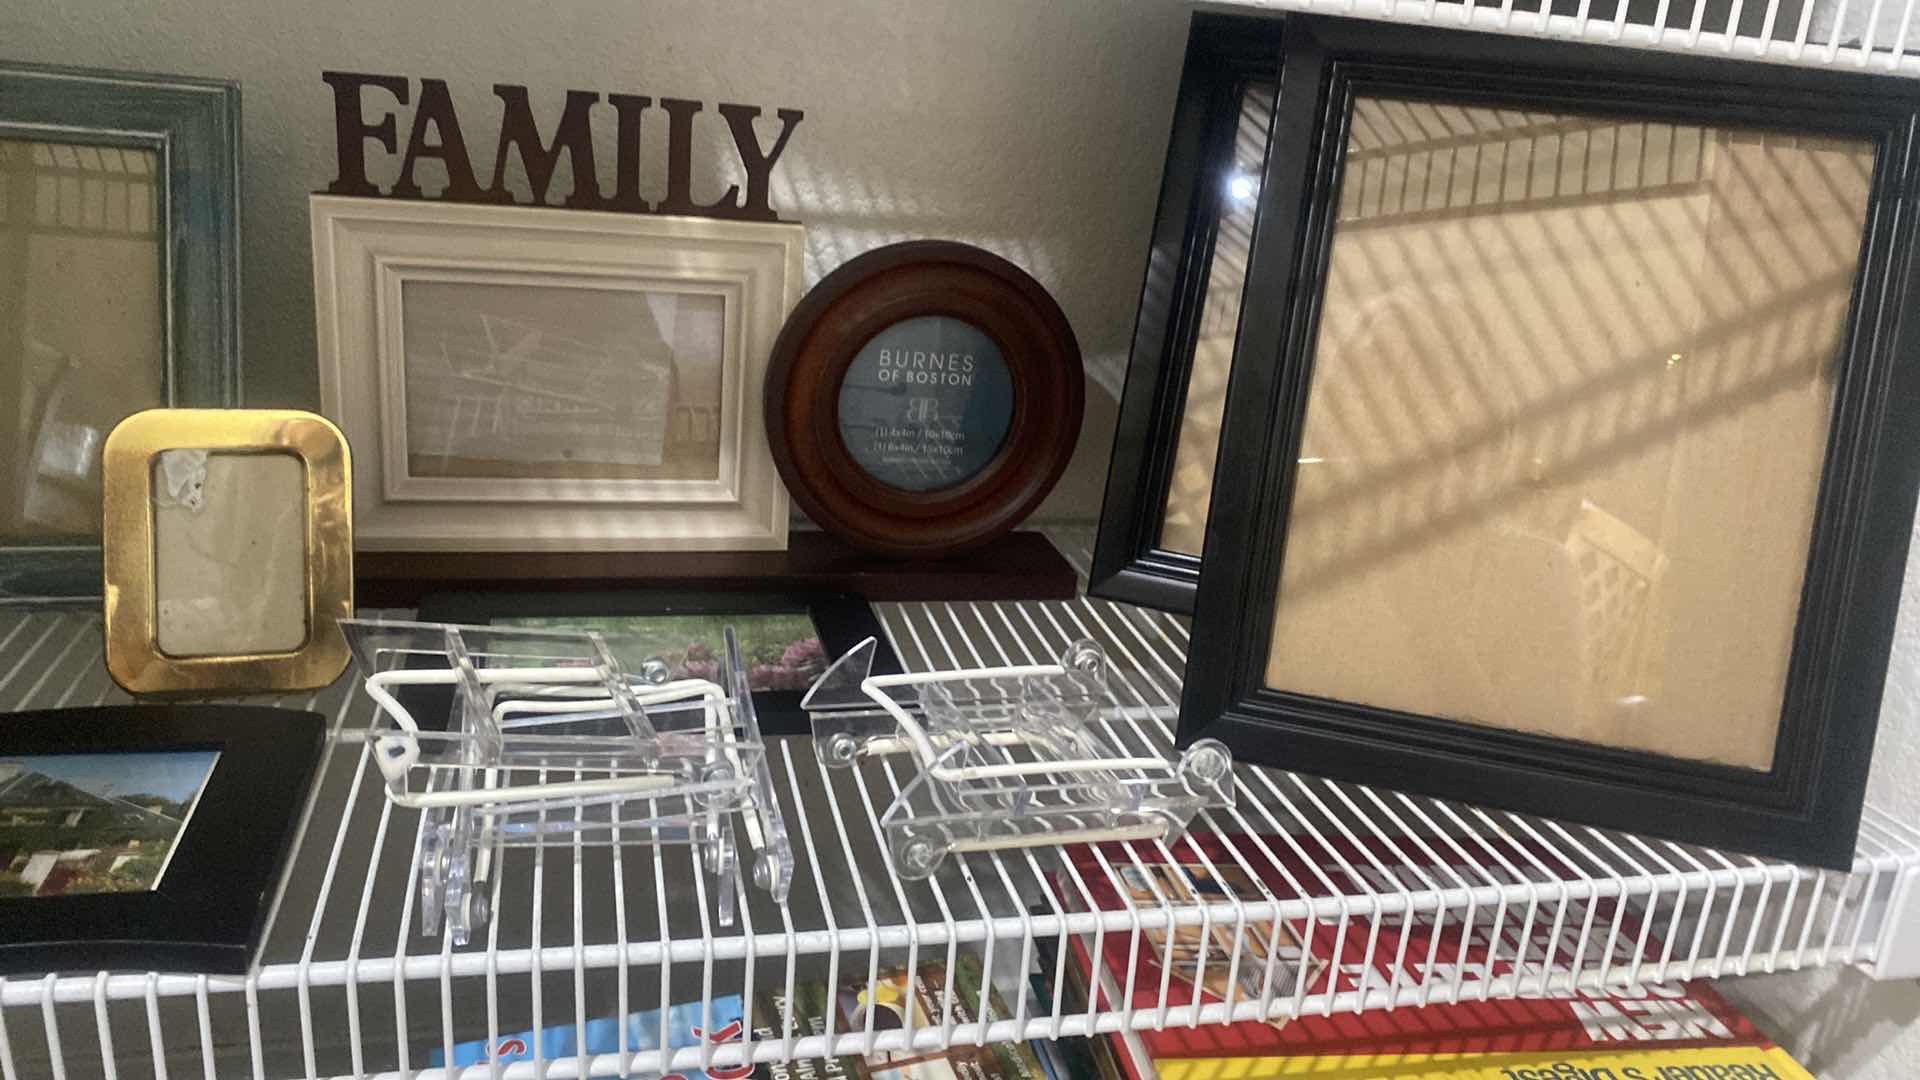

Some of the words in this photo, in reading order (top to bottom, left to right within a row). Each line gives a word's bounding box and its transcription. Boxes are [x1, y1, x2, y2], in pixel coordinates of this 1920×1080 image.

[322, 71, 804, 221] FAMILY
[879, 350, 974, 372] BURNES
[878, 369, 900, 382] OF
[906, 371, 973, 386] BOSTON
[1569, 999, 1735, 1041] NEW
